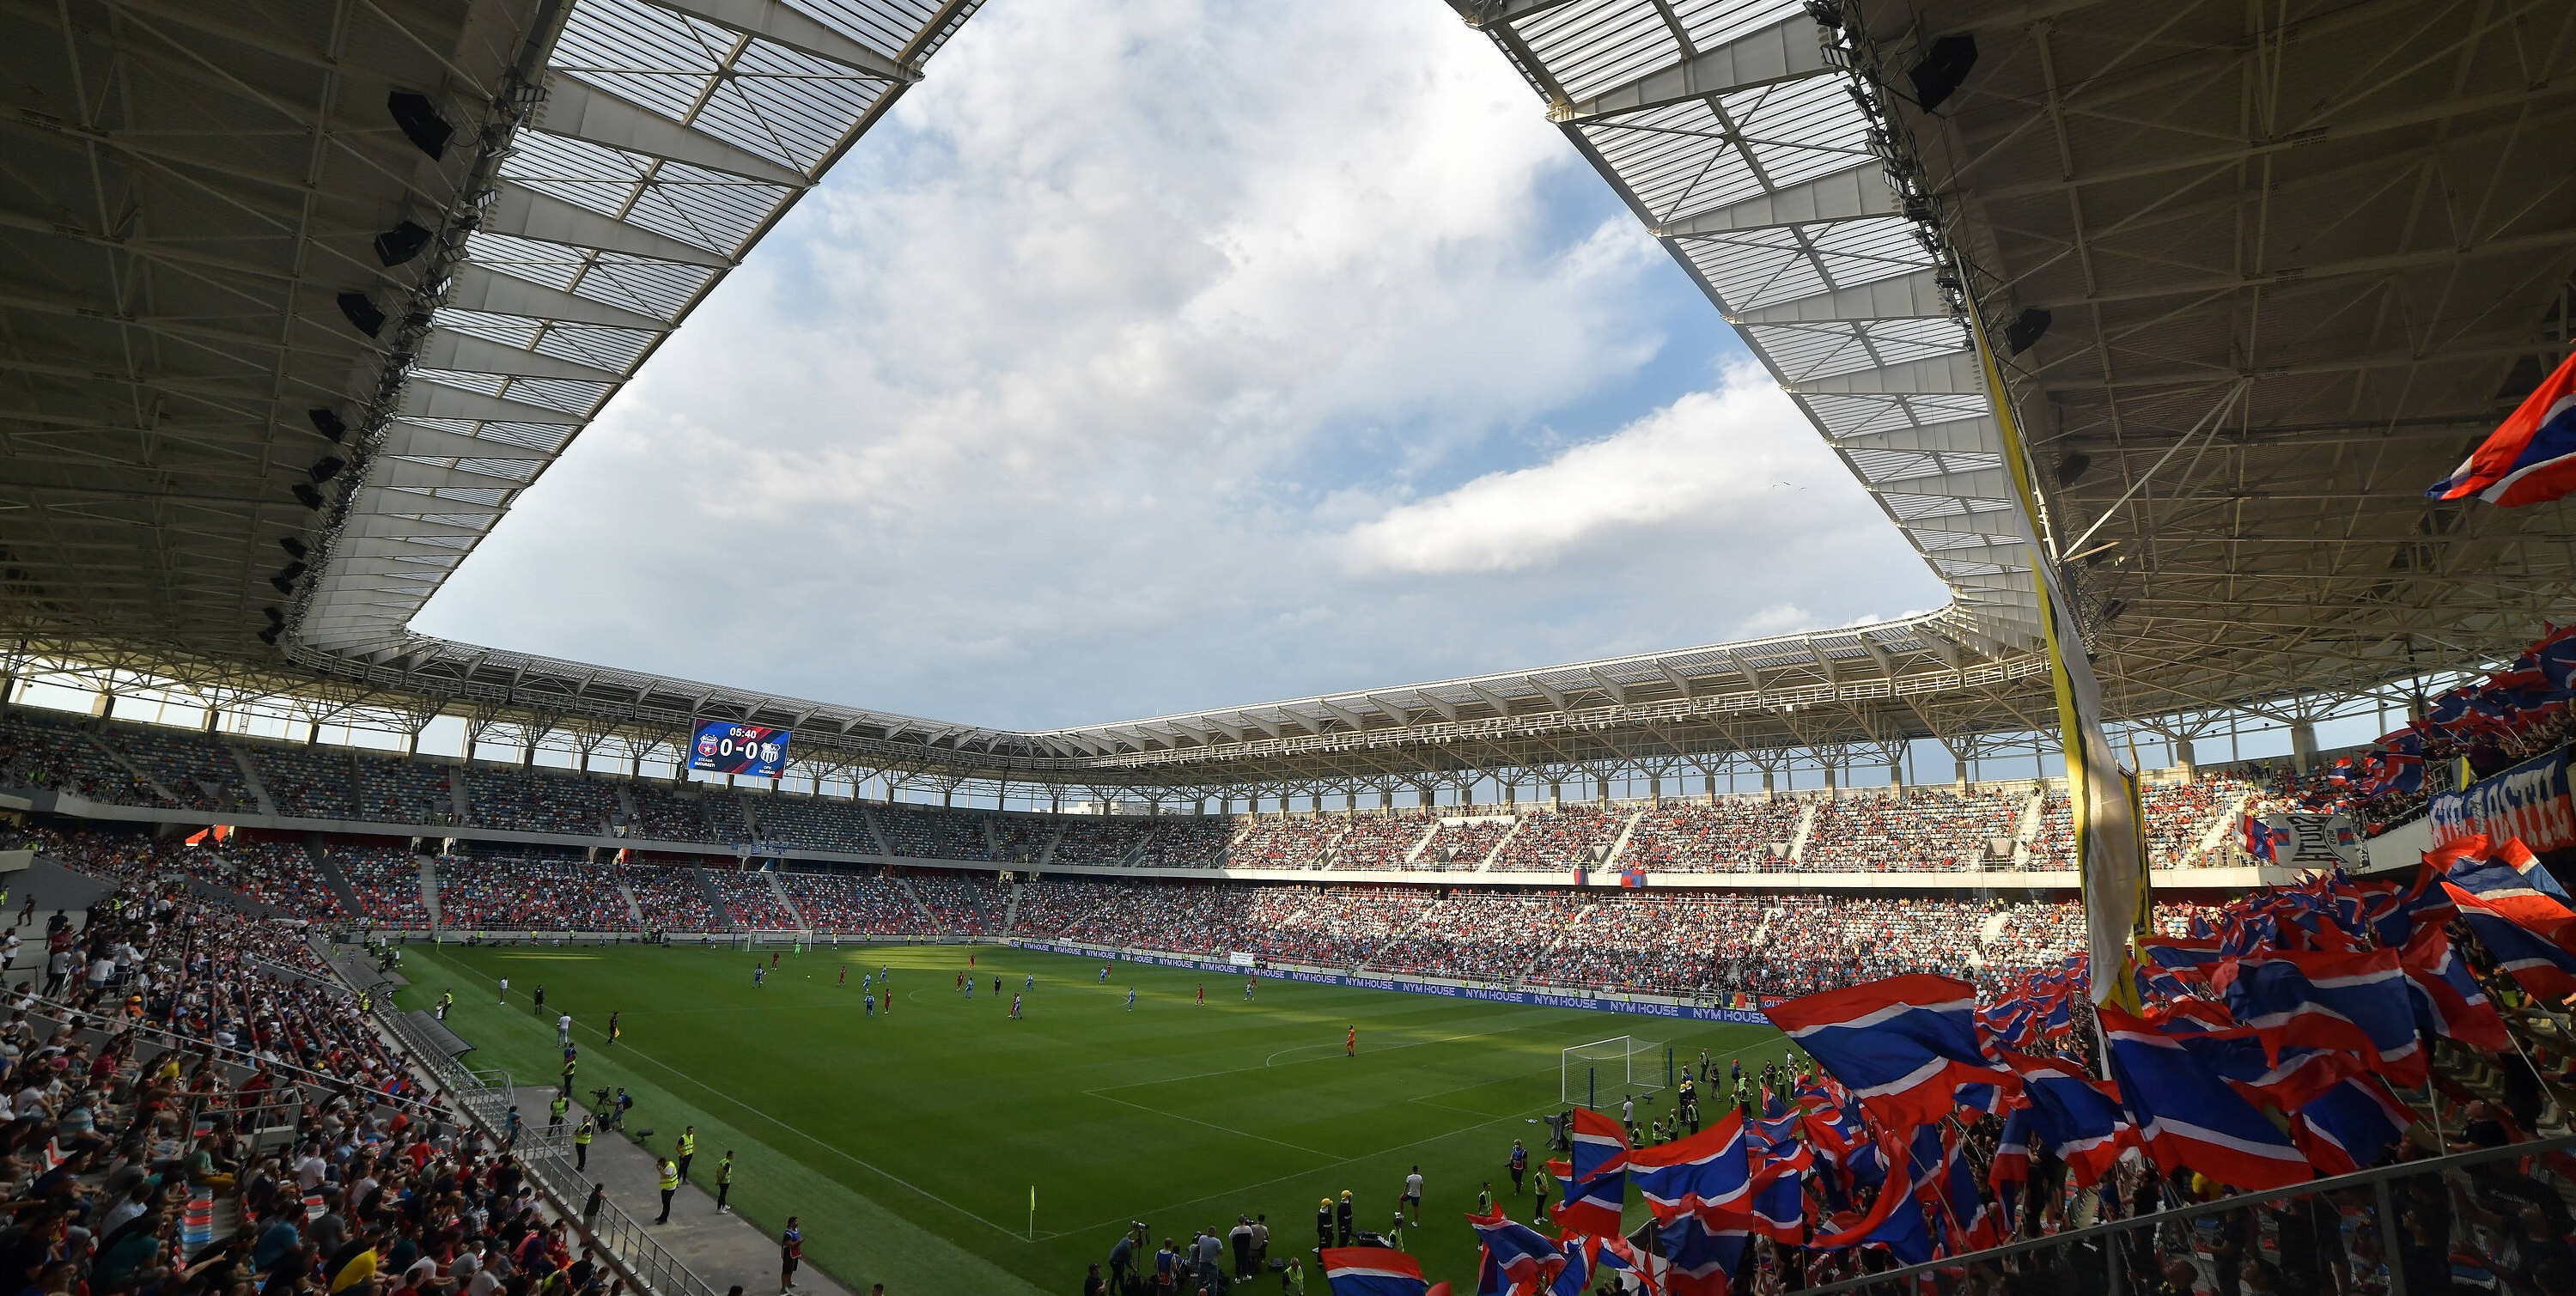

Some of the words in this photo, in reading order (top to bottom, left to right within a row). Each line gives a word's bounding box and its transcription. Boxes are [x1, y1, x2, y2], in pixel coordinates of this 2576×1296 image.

[730, 727, 756, 739] 05:40
[1099, 951, 1116, 959] HOUSE
[1134, 955, 1154, 964] HOUSE
[1172, 959, 1194, 969] HOUSE
[1199, 962, 1214, 970] NYM
[1215, 964, 1238, 973] HOUSE
[1260, 969, 1285, 978] HOUSE
[1292, 971, 1310, 982] NYM
[1310, 974, 1337, 984] HOUSE
[1345, 977, 1364, 987] NYM
[1365, 980, 1393, 990] HOUSE
[1403, 983, 1422, 993] NYM
[1425, 984, 1456, 996] HOUSE
[1465, 989, 1487, 1000] NYM
[1489, 990, 1523, 1003] HOUSE
[1534, 995, 1558, 1006] NYM
[1560, 996, 1598, 1009] HOUSE
[1609, 1001, 1635, 1013] NYM
[1637, 1003, 1679, 1017] HOUSE
[1693, 1007, 1721, 1020] NYM
[1724, 1010, 1769, 1025] HOUSE
